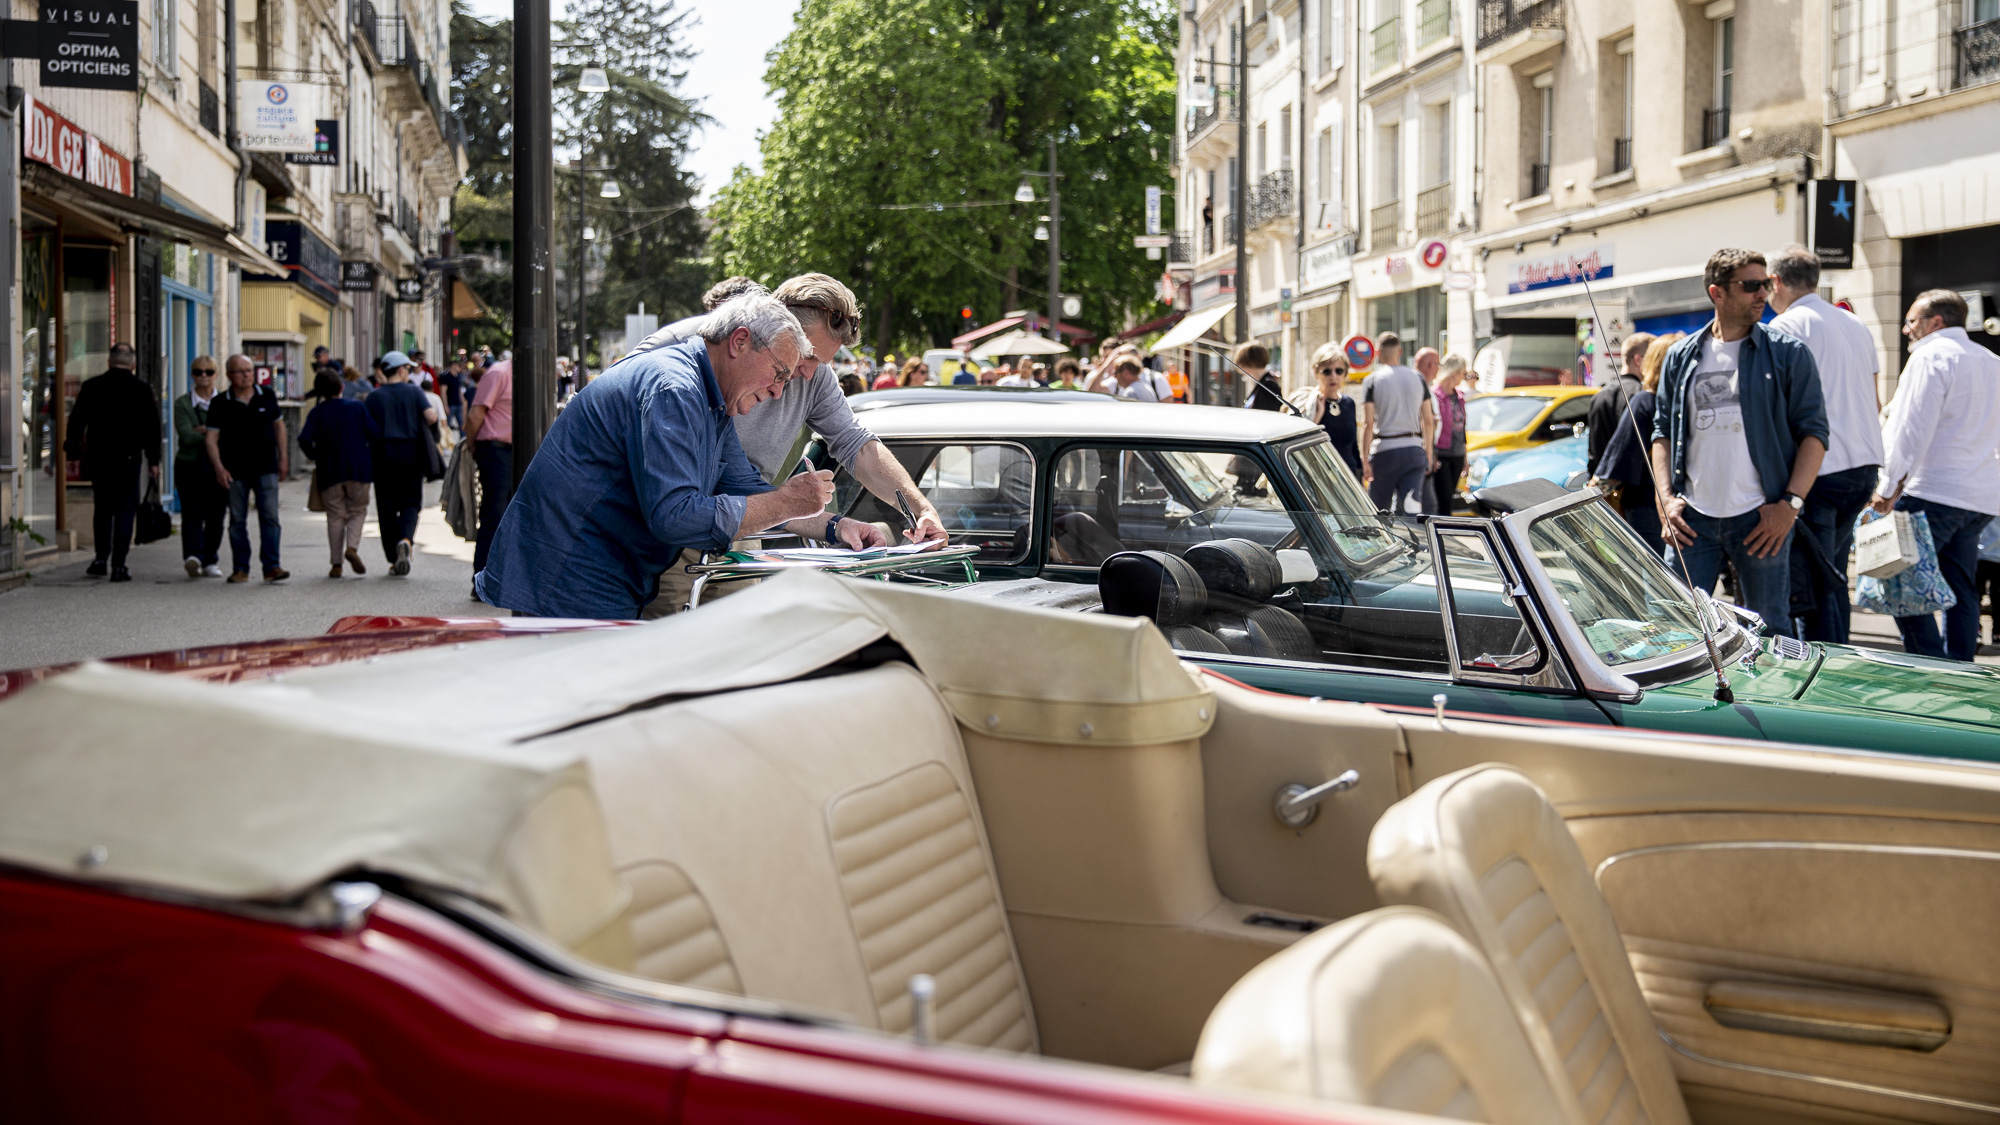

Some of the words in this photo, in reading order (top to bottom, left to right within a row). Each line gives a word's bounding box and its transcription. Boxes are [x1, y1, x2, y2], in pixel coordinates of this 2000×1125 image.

[46, 8, 131, 25] VISUAL
[58, 43, 120, 58] OPTIMA
[47, 59, 131, 76] OPTICIENS
[32, 106, 54, 164] DI
